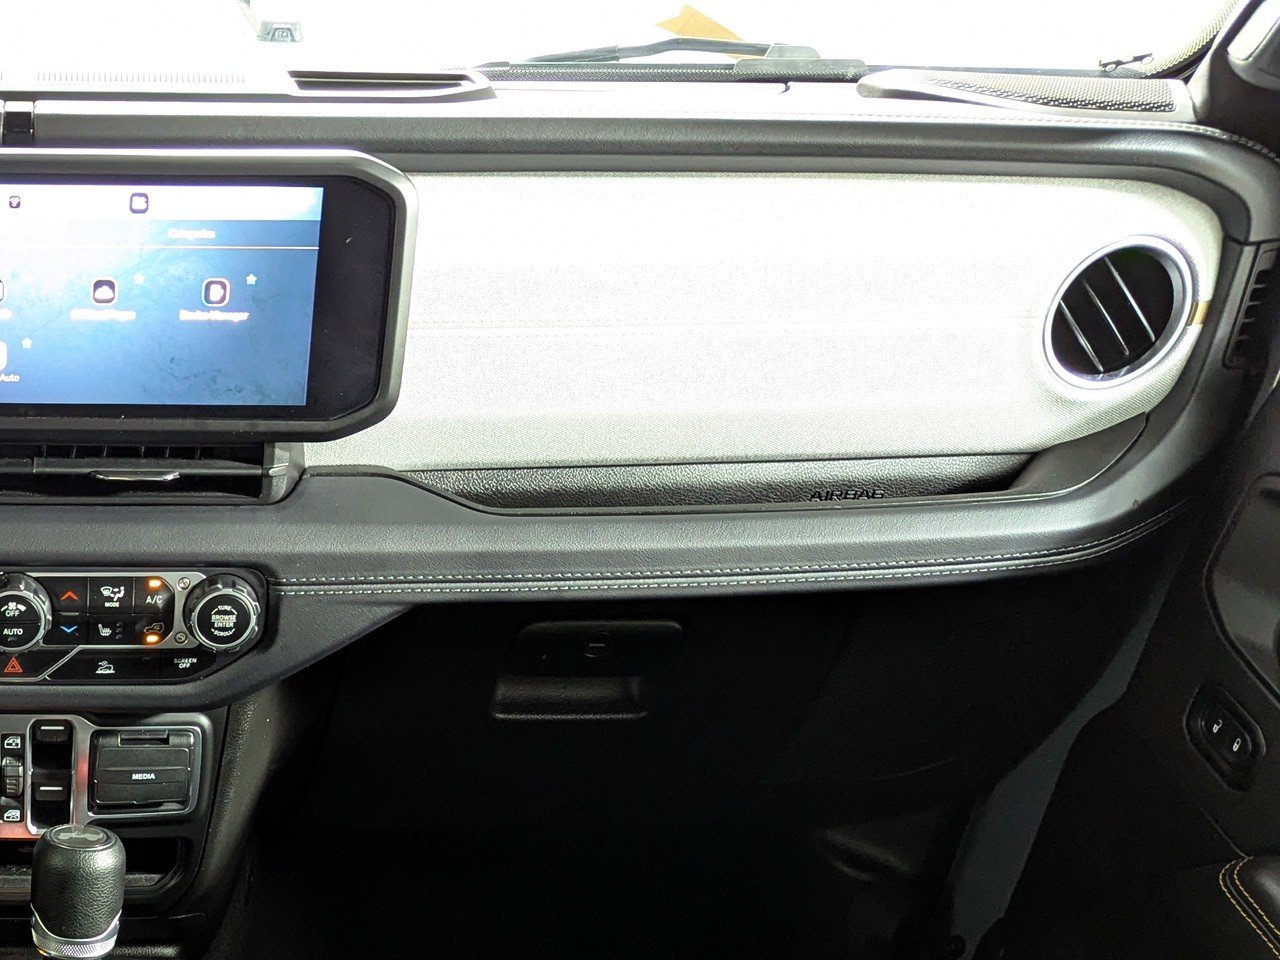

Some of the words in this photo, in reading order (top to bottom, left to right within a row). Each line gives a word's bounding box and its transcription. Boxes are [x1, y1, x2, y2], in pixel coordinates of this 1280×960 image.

[0, 373, 20, 383] Auto
[809, 489, 886, 501] AIRBAG
[146, 595, 163, 604] A/C
[5, 610, 20, 618] OFF
[3, 628, 23, 636] AUTO
[174, 657, 197, 665] SCREEN
